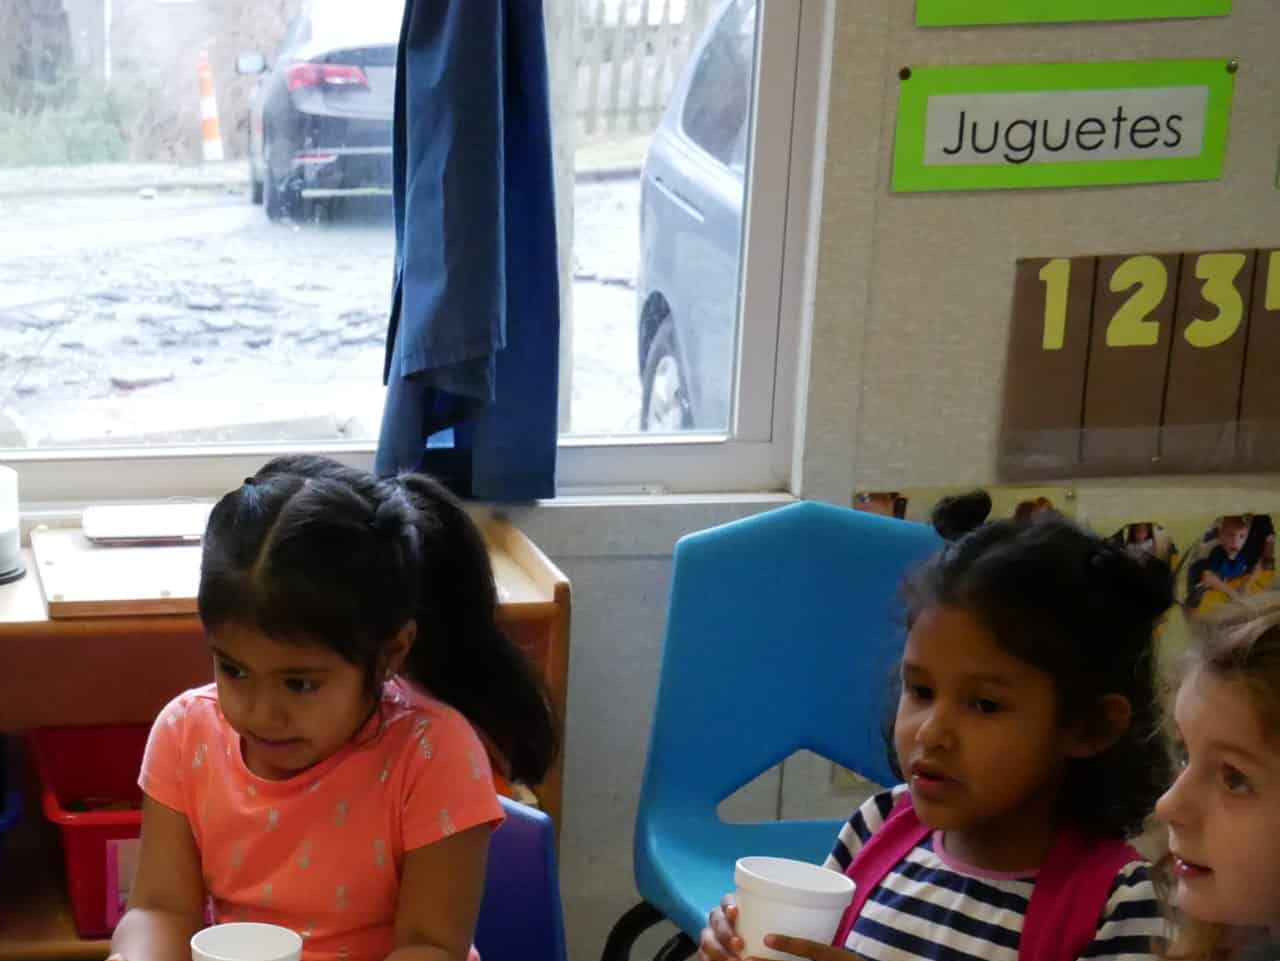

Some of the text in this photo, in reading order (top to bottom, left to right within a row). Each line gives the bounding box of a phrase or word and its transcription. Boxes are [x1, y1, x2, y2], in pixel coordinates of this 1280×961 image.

[942, 105, 1184, 165] Juguetes
[1038, 258, 1072, 350] 1
[1105, 255, 1169, 348] 2
[1183, 253, 1247, 348] 3
